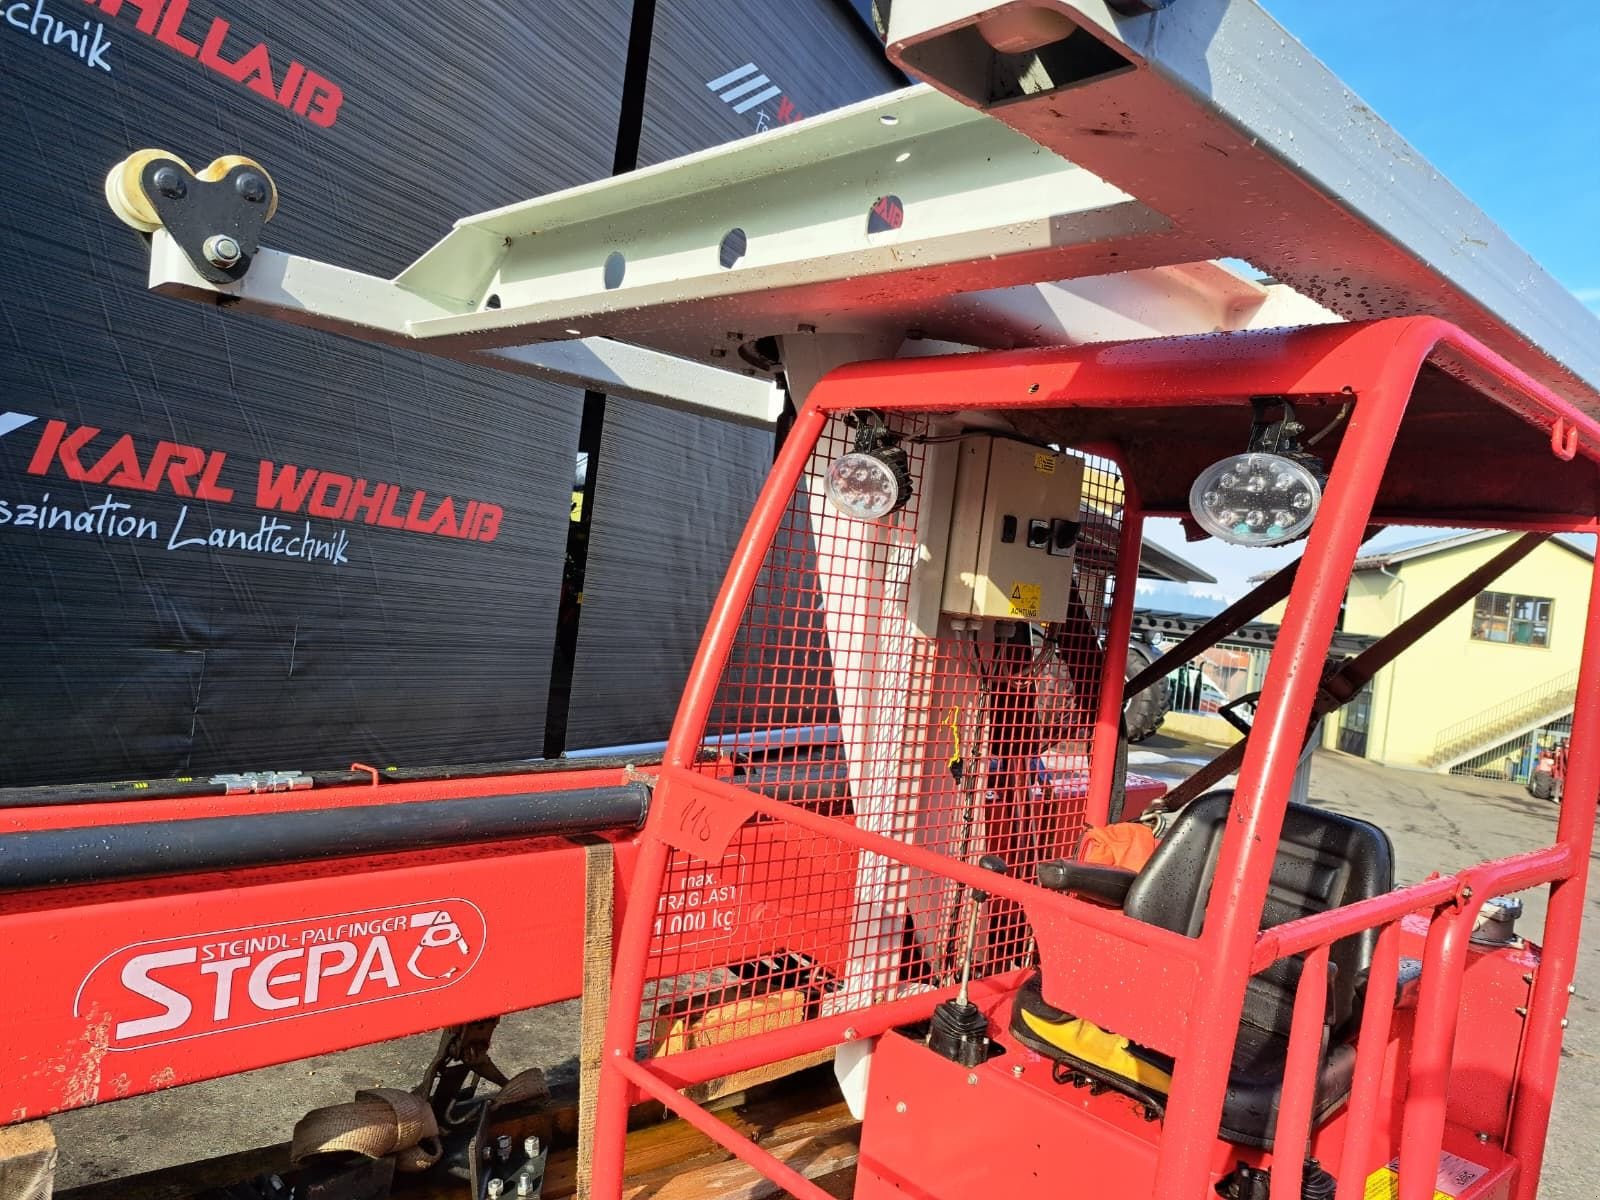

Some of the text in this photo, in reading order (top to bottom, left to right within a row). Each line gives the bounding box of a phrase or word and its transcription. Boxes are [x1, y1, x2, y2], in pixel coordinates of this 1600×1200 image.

[27, 419, 503, 543] KARL WOHLLAIB
[167, 505, 349, 565] Landtechnik
[681, 873, 717, 889] max.
[202, 915, 407, 961] STEINDL-PALFINGER
[115, 935, 401, 1041] STEPA
